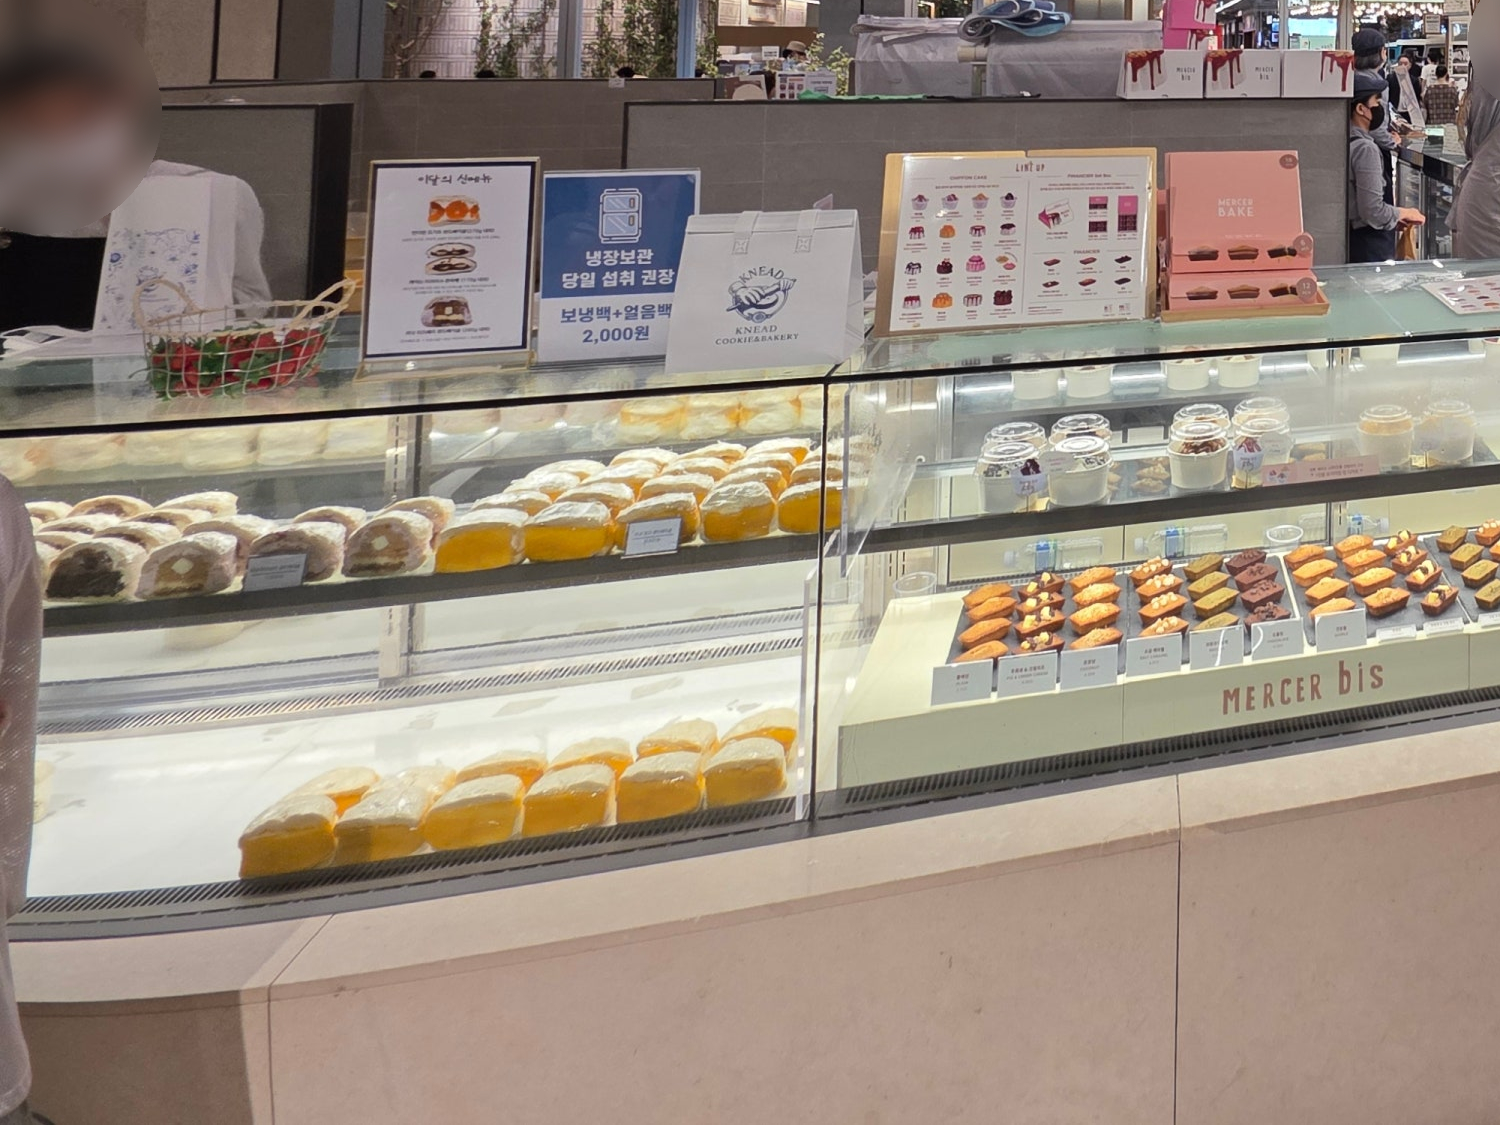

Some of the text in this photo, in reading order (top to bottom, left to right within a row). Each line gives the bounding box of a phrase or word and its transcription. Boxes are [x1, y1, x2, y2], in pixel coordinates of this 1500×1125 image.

[417, 174, 452, 186] 이달의
[1217, 197, 1254, 207] MERCER
[1217, 206, 1255, 218] BAKE
[585, 249, 655, 267] 냉장보관
[561, 268, 675, 290] 당일 섭취 권장
[738, 265, 785, 284] KNEAD
[560, 303, 673, 325] 보냉백+얼음백
[582, 325, 650, 346] 2,000원
[735, 324, 778, 335] KNEAD
[715, 333, 799, 346] COOKIE&BAKERY
[1221, 660, 1384, 716] MERCER bis
